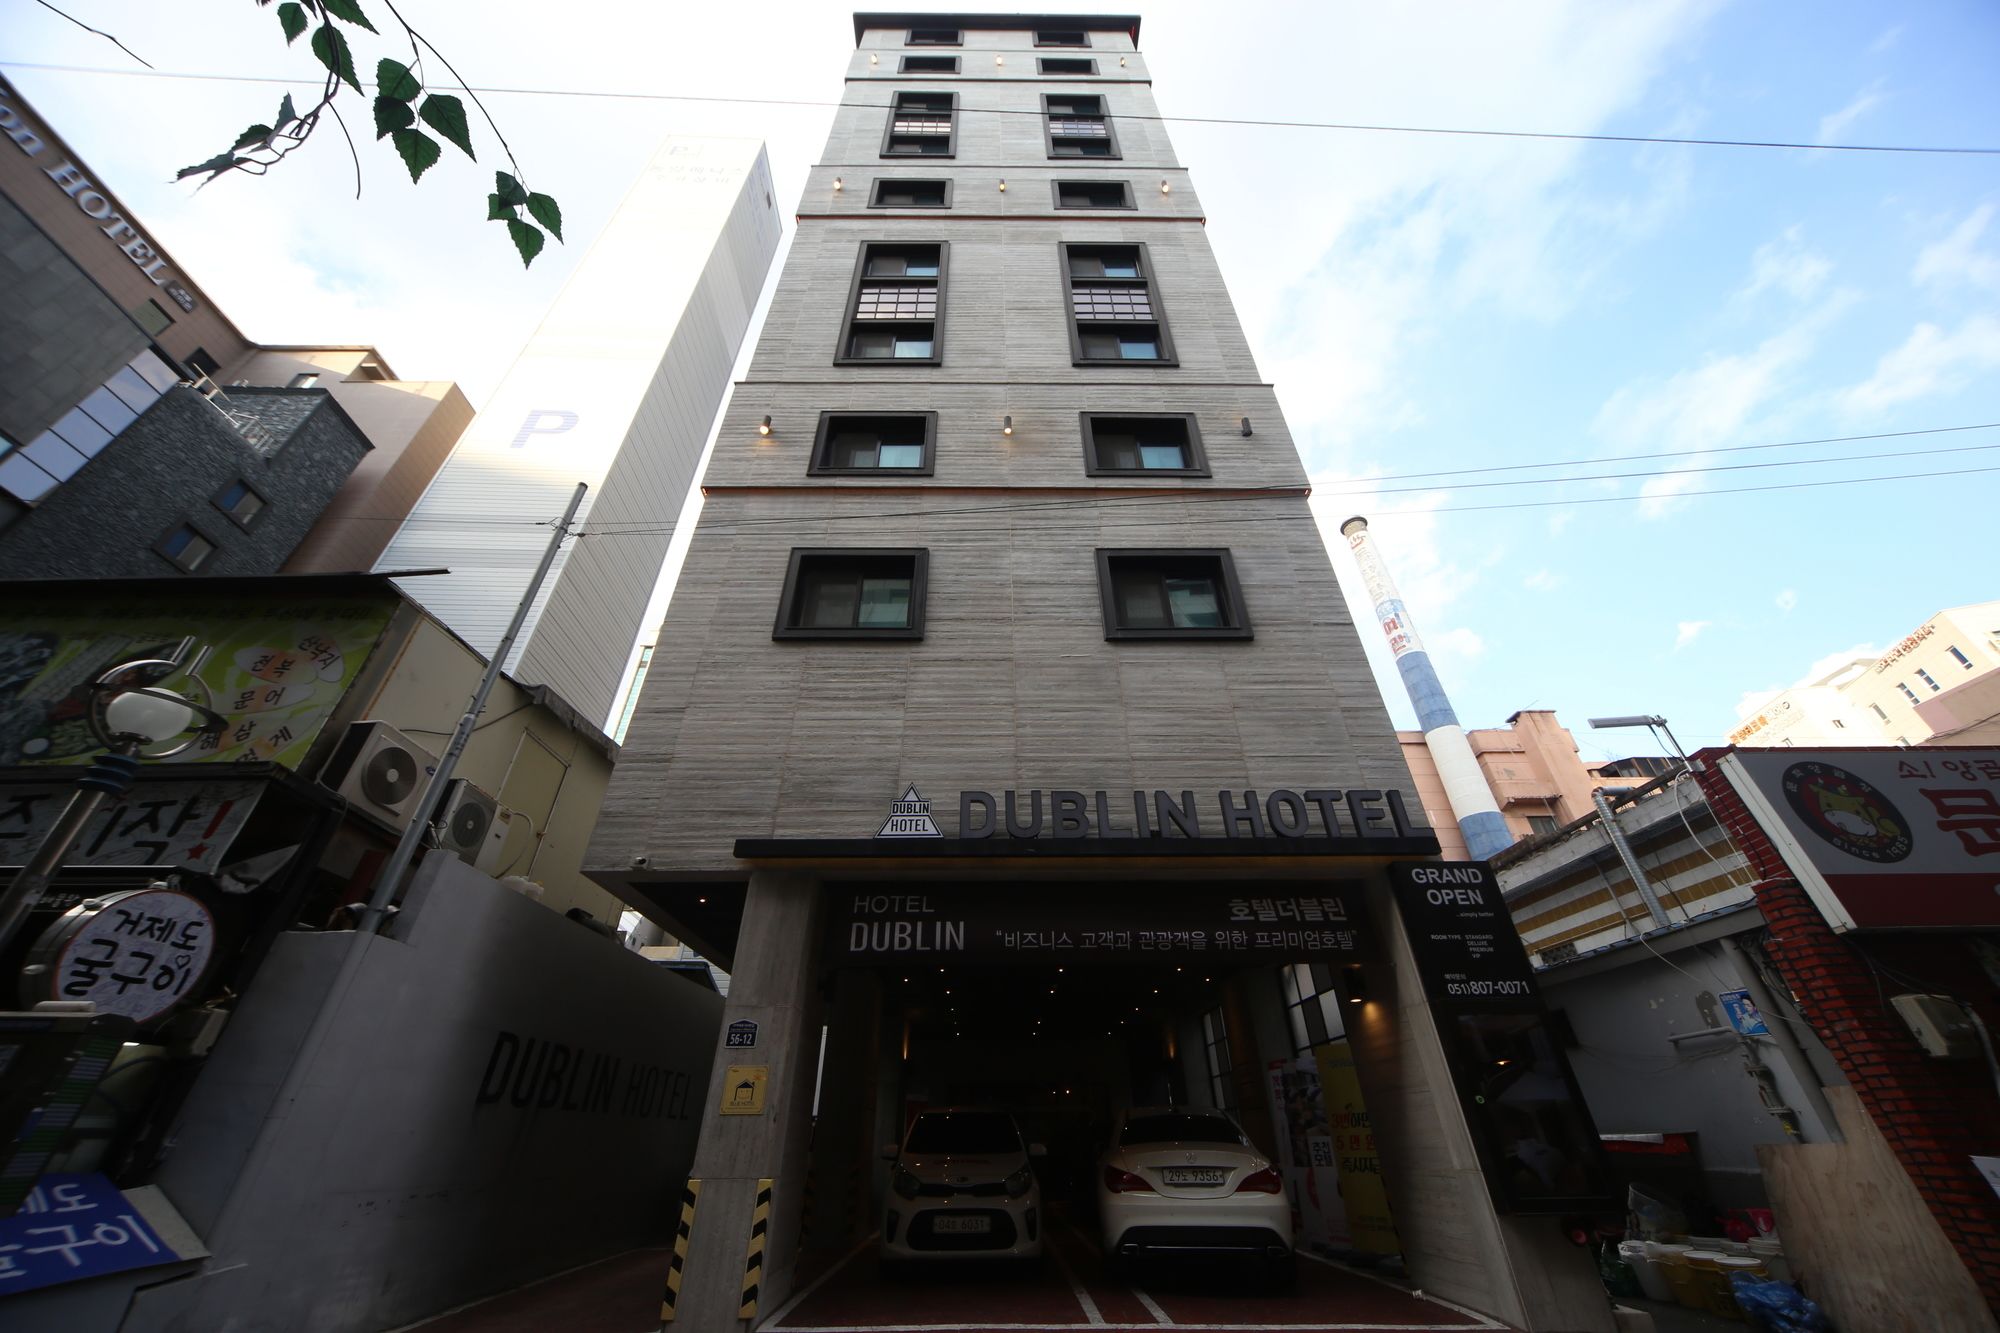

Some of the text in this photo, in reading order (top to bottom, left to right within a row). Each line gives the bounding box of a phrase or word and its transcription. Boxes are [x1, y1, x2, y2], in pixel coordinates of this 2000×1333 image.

[0, 86, 168, 286] on HOTEL
[510, 409, 579, 448] P
[234, 687, 286, 711] 문어
[892, 802, 929, 814] DUBLIN
[960, 789, 1435, 838] DUBLIN HOTEL
[890, 818, 928, 832] HOTEL
[1411, 868, 1483, 884] GRAND
[853, 895, 935, 913] HOTEL
[1426, 889, 1484, 905] OPEN
[1228, 897, 1348, 922] 호텔더블린
[113, 908, 204, 950] 거제도
[850, 920, 965, 951] DUBLIN
[1079, 930, 1132, 950] 고객과
[1139, 930, 1208, 951] 관광객을
[1215, 930, 1248, 950] 위한
[63, 938, 191, 996] 굴구이
[1447, 980, 1530, 995] 051)807-0071
[729, 1033, 753, 1045] 56-12
[475, 1031, 692, 1120] DUBLIN HOTEL
[1192, 1170, 1219, 1182] 9356
